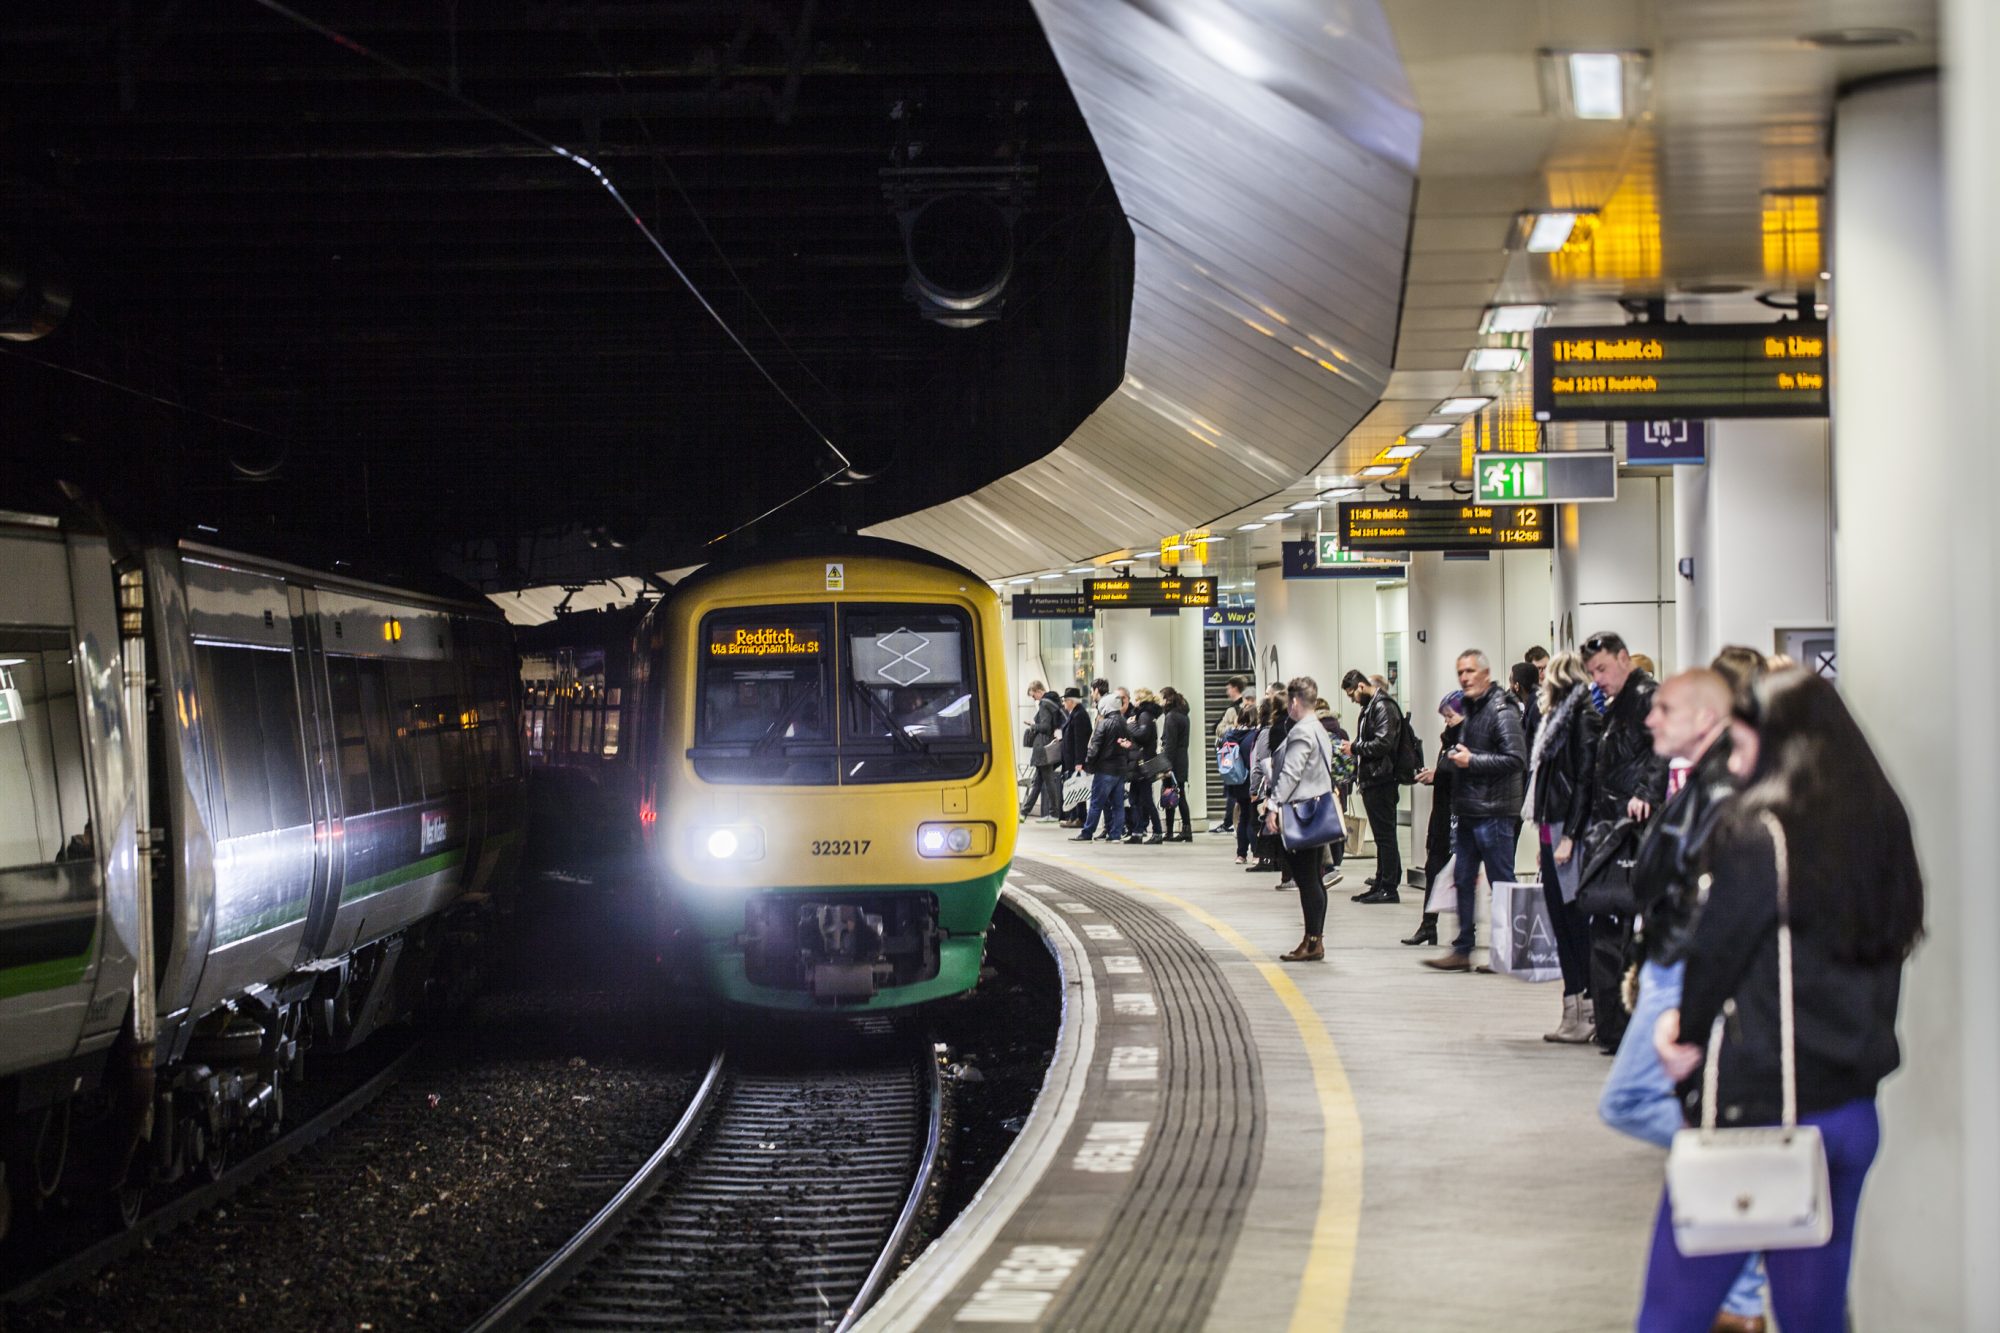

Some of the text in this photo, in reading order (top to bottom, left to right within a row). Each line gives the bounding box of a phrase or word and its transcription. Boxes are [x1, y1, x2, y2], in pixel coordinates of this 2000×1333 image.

[1350, 508, 1408, 520] 11:45 Redditch
[1462, 507, 1473, 518] On
[1517, 508, 1537, 526] 12
[1194, 581, 1207, 594] 12
[1227, 612, 1246, 623] Way
[736, 628, 794, 645] Redditch
[728, 643, 784, 655] Birmingham
[786, 642, 805, 653] New
[807, 641, 819, 652] St
[812, 840, 871, 855] 323217
